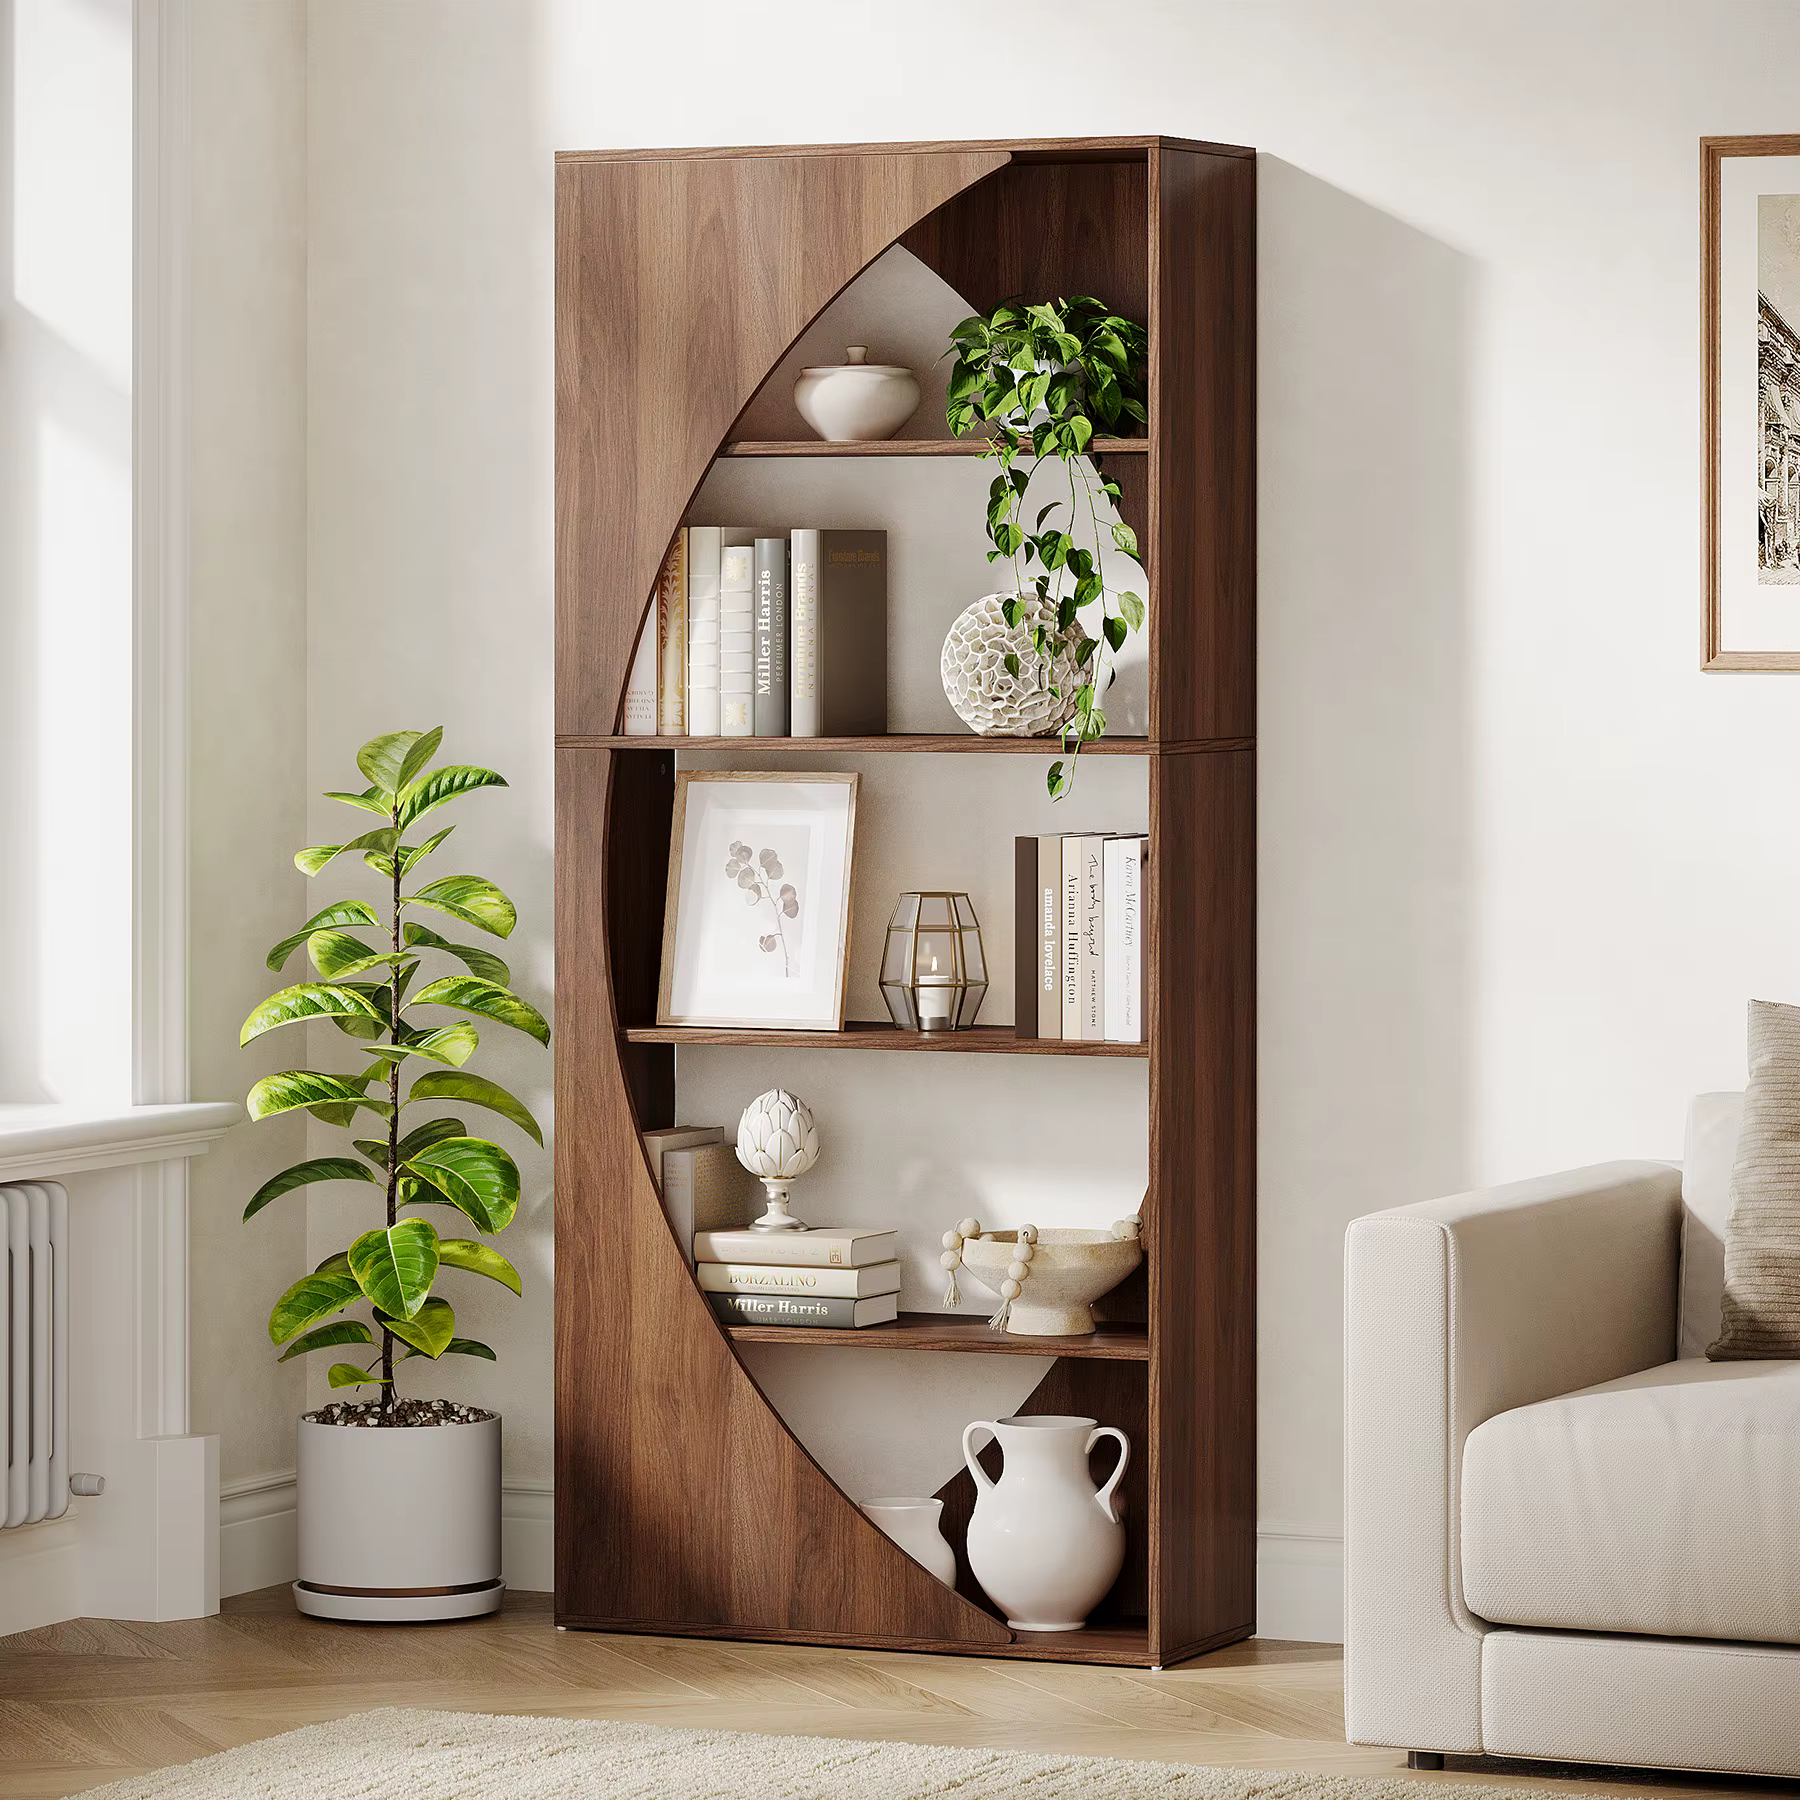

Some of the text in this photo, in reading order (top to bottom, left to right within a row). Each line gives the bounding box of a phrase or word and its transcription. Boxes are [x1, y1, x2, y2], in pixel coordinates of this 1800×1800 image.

[757, 569, 771, 696] Miller Harris
[775, 583, 783, 682] PERFUMER LONDON
[794, 562, 807, 698] Furniture Brands
[1088, 853, 1099, 880] The
[1125, 856, 1136, 887] Karen
[1088, 883, 1101, 910] body
[1122, 890, 1136, 947] McCartney
[1044, 887, 1056, 991] amanda lovelace
[1065, 874, 1079, 1005] Arianna Huffington
[728, 1271, 817, 1288] BORZALINO
[727, 1297, 829, 1316] Miller Harris
[782, 1317, 818, 1325] LONDON
